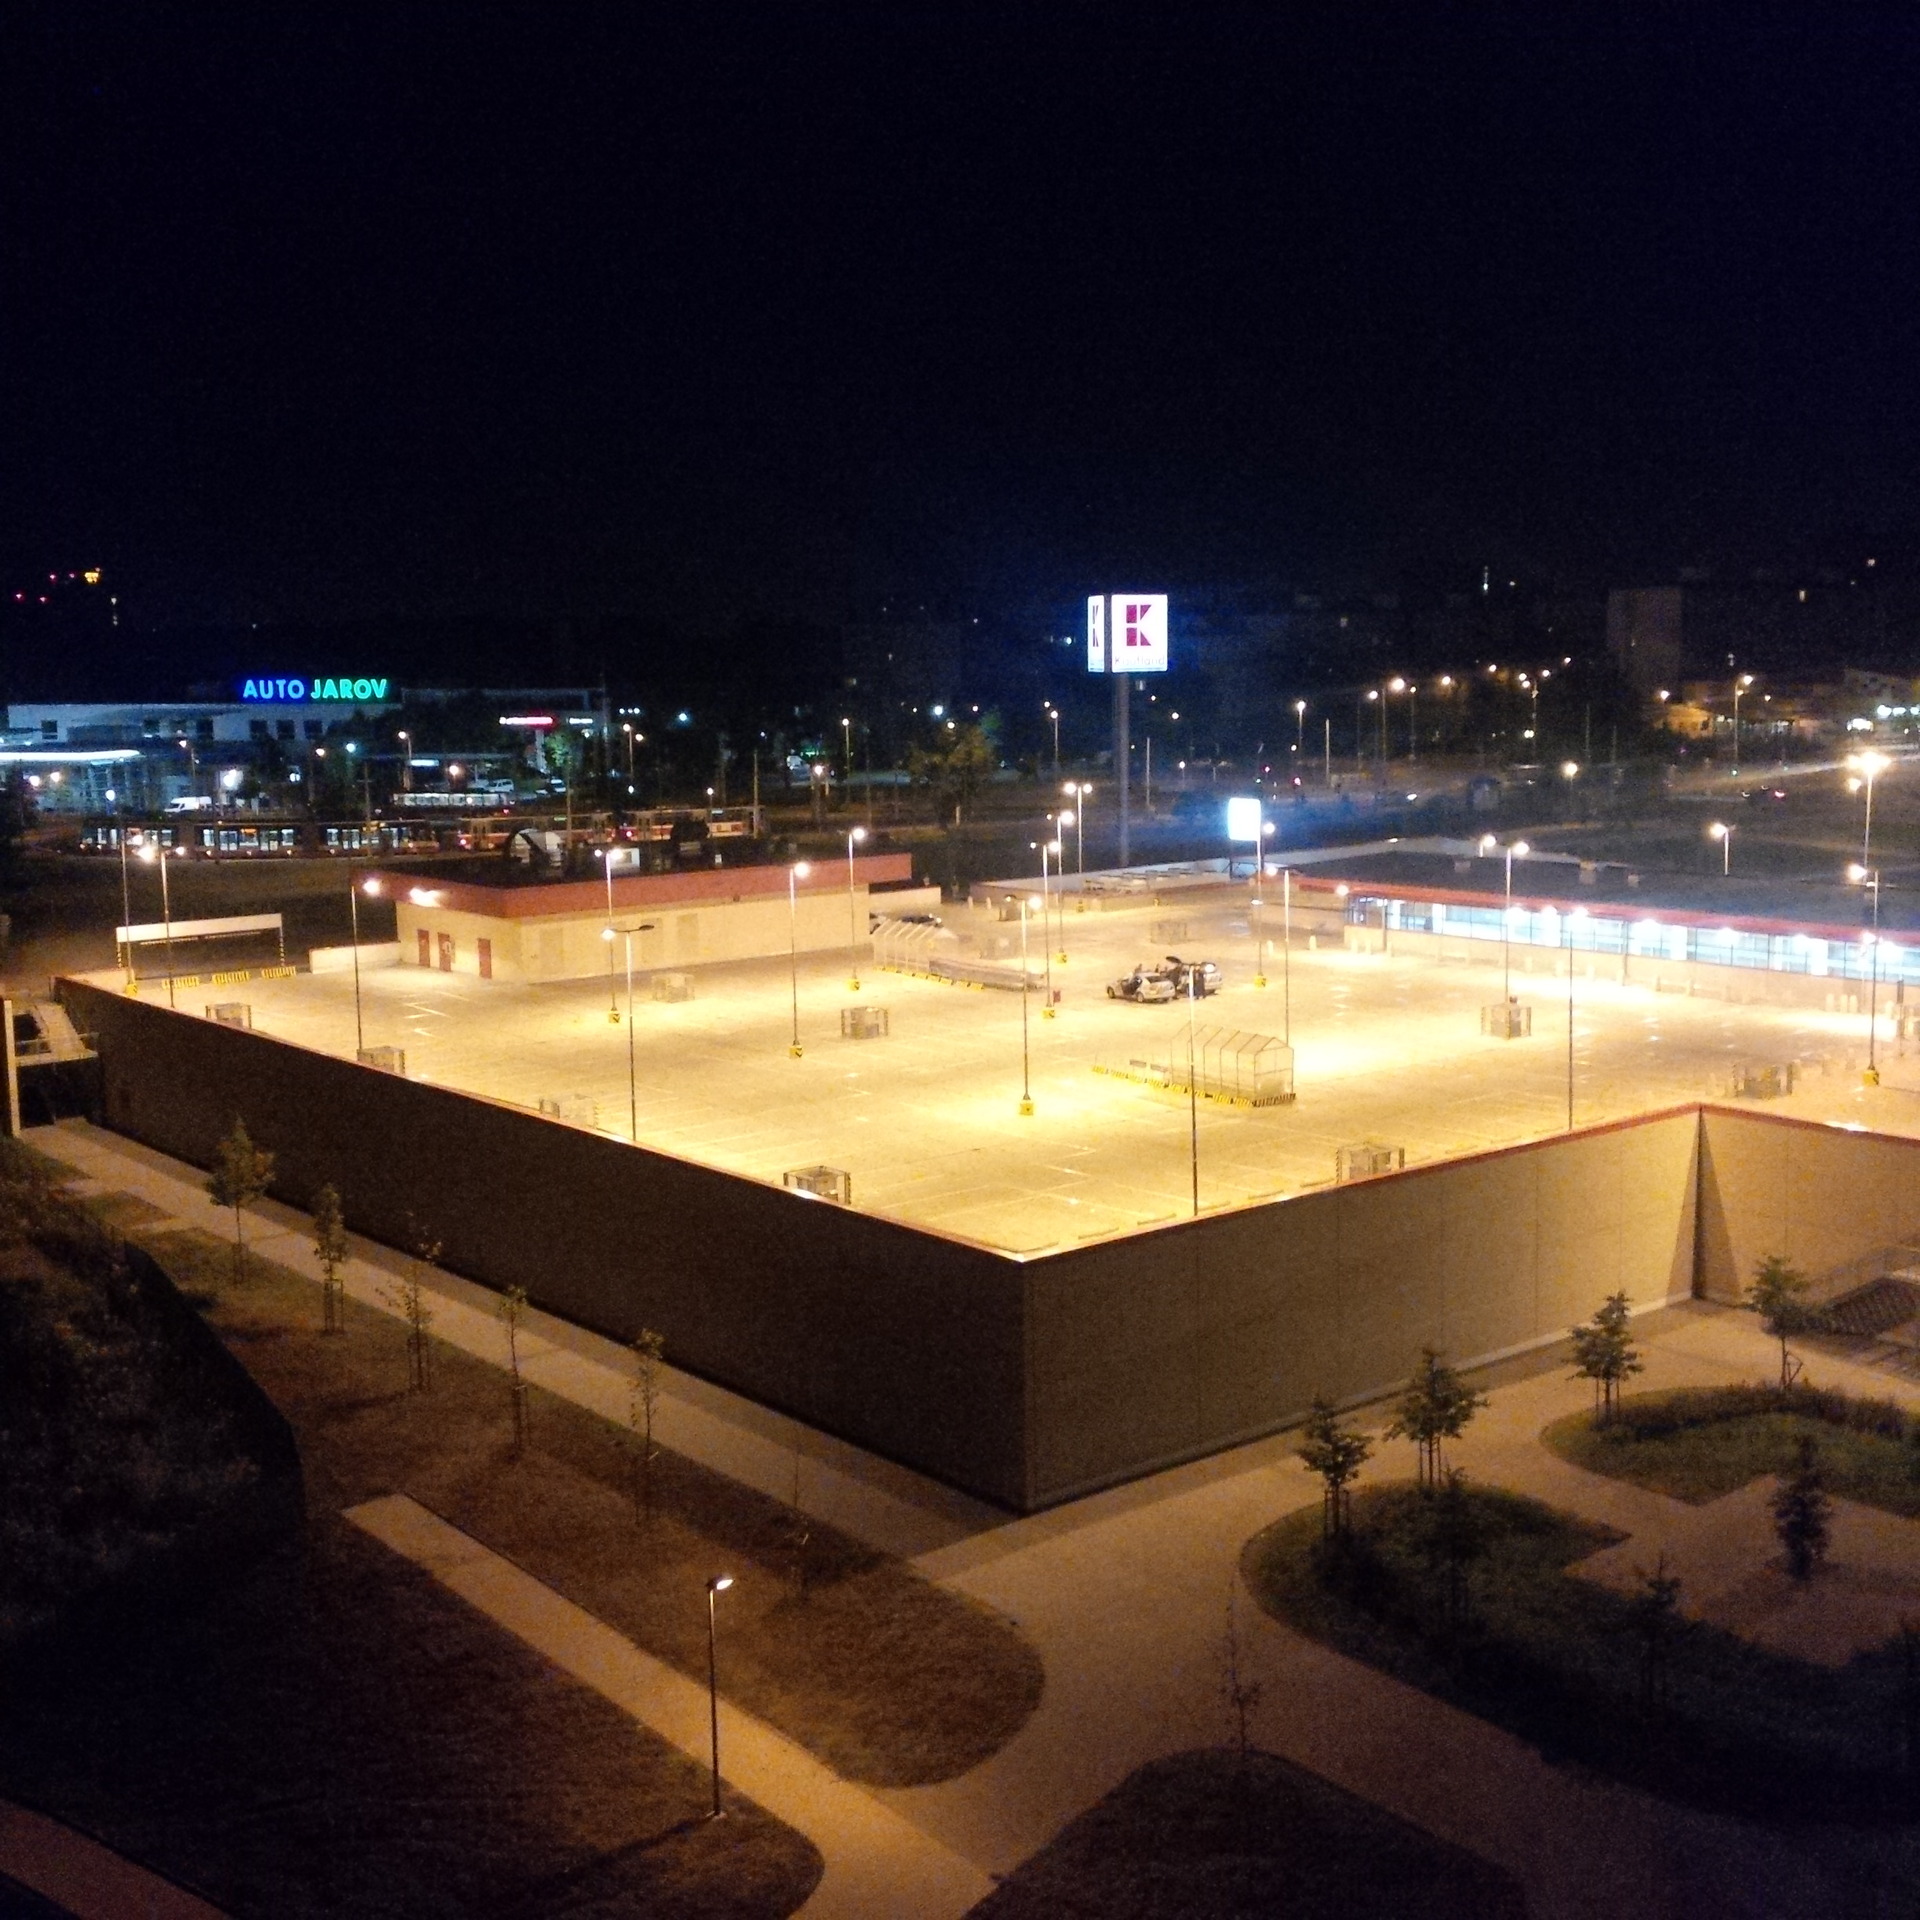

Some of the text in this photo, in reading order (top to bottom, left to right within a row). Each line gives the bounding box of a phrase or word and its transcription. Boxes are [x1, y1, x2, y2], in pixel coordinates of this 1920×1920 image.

[1126, 604, 1152, 647] K
[1115, 656, 1165, 666] Kfland
[243, 678, 388, 700] AUTO JAROV
